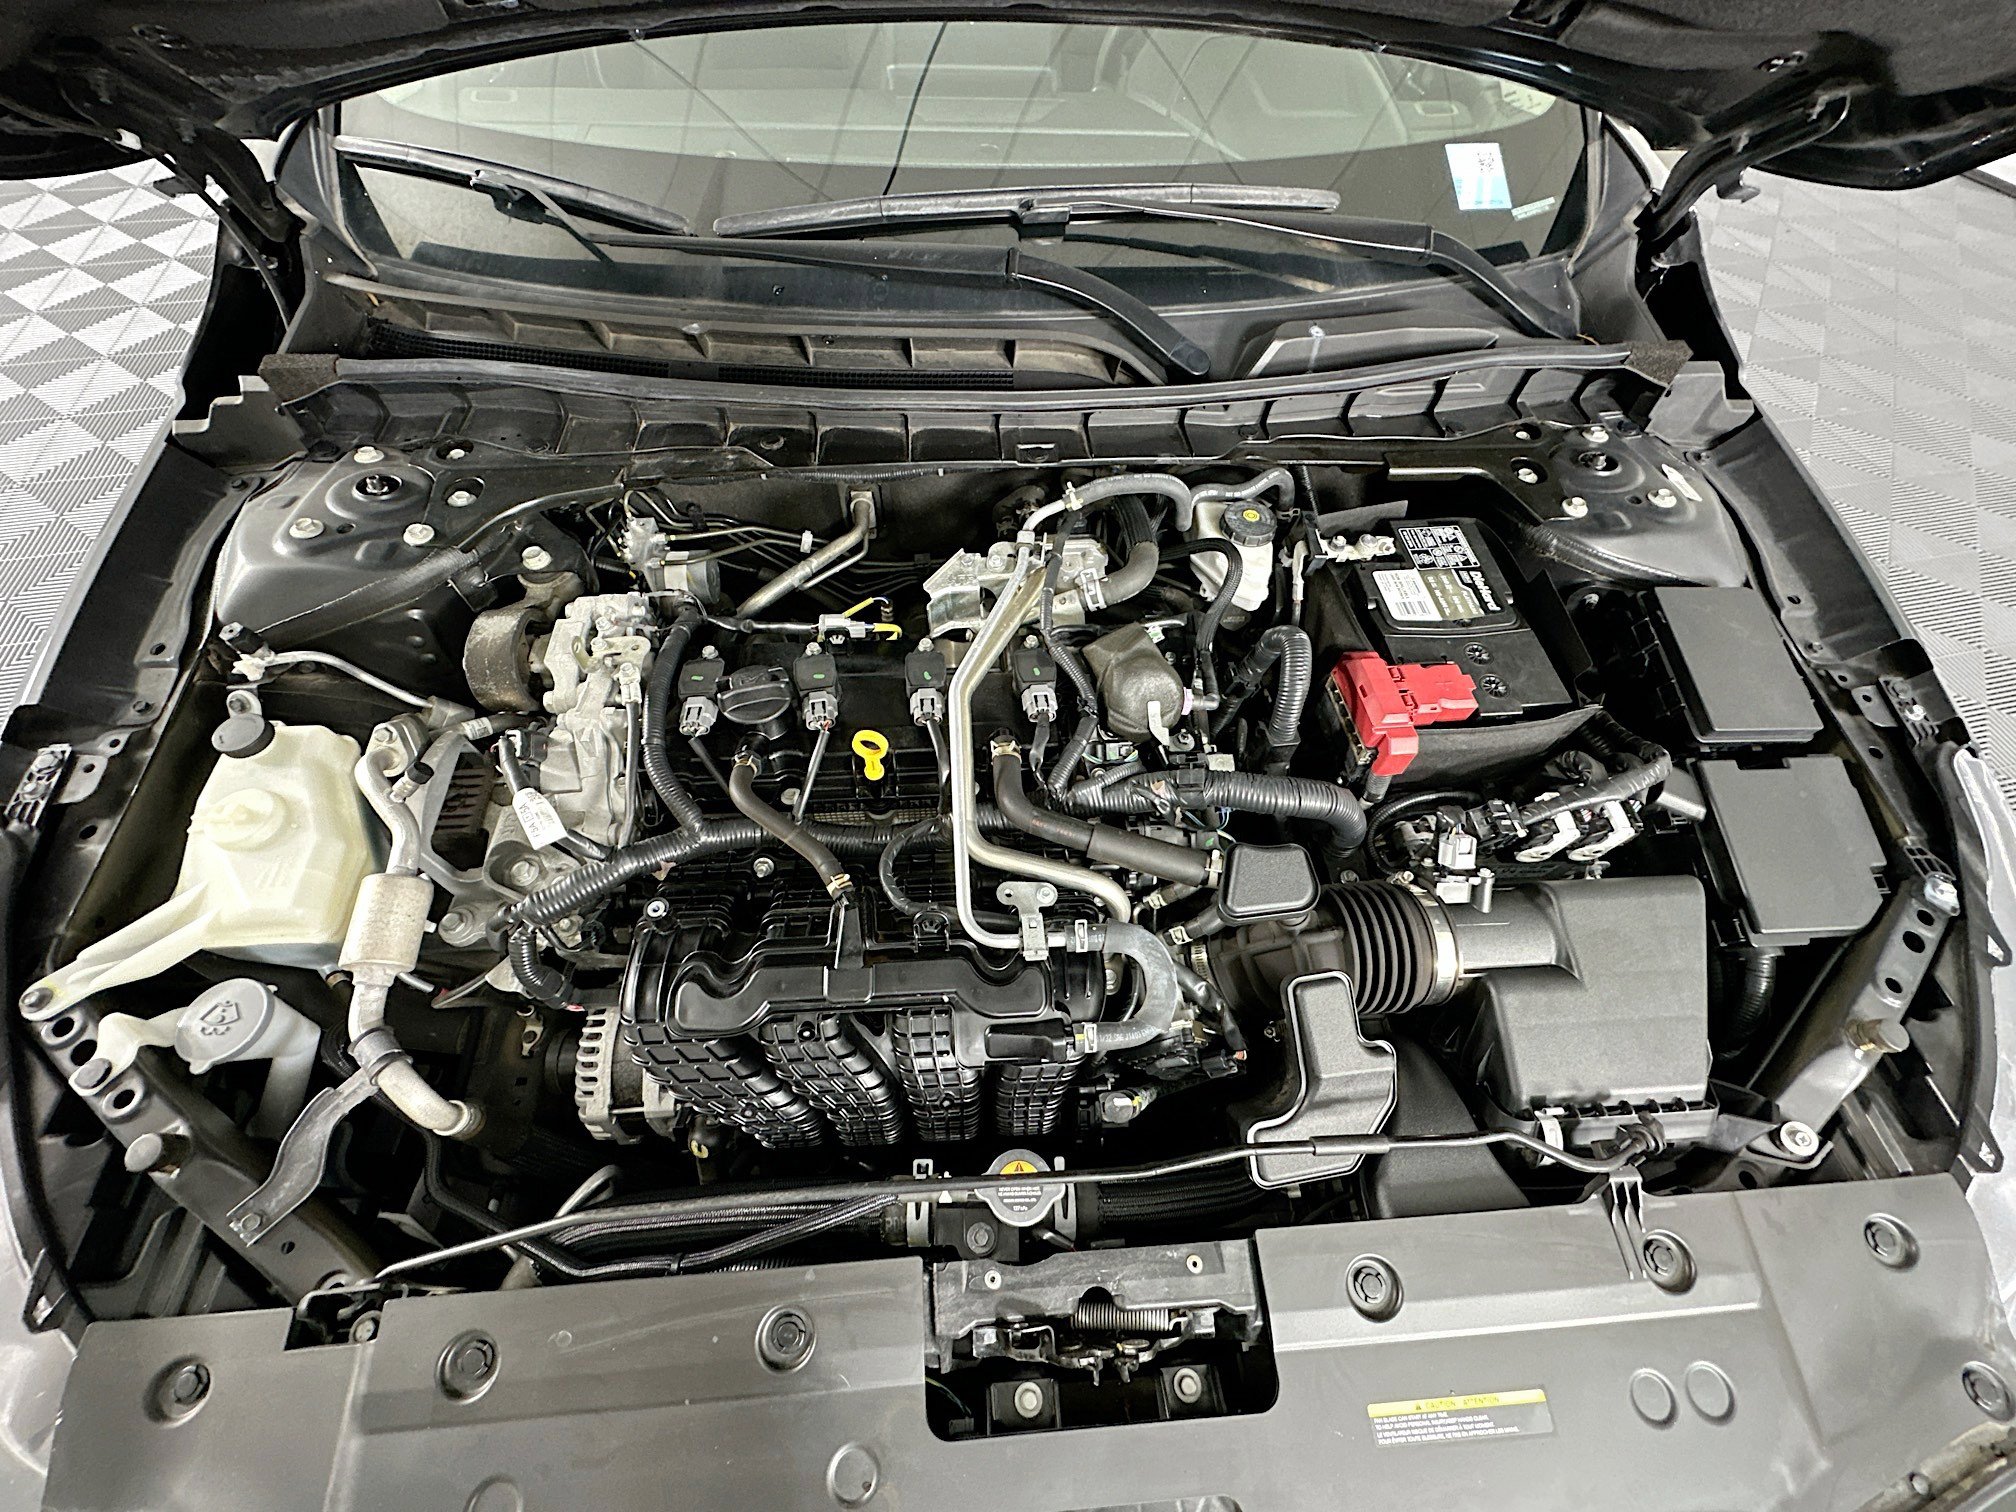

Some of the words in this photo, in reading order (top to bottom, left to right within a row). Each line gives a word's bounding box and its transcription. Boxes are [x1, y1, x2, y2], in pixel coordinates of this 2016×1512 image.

[1469, 570, 1501, 611] DieHard
[1425, 1400, 1456, 1410] CAUTION
[1463, 1396, 1500, 1407] ATTENTION
